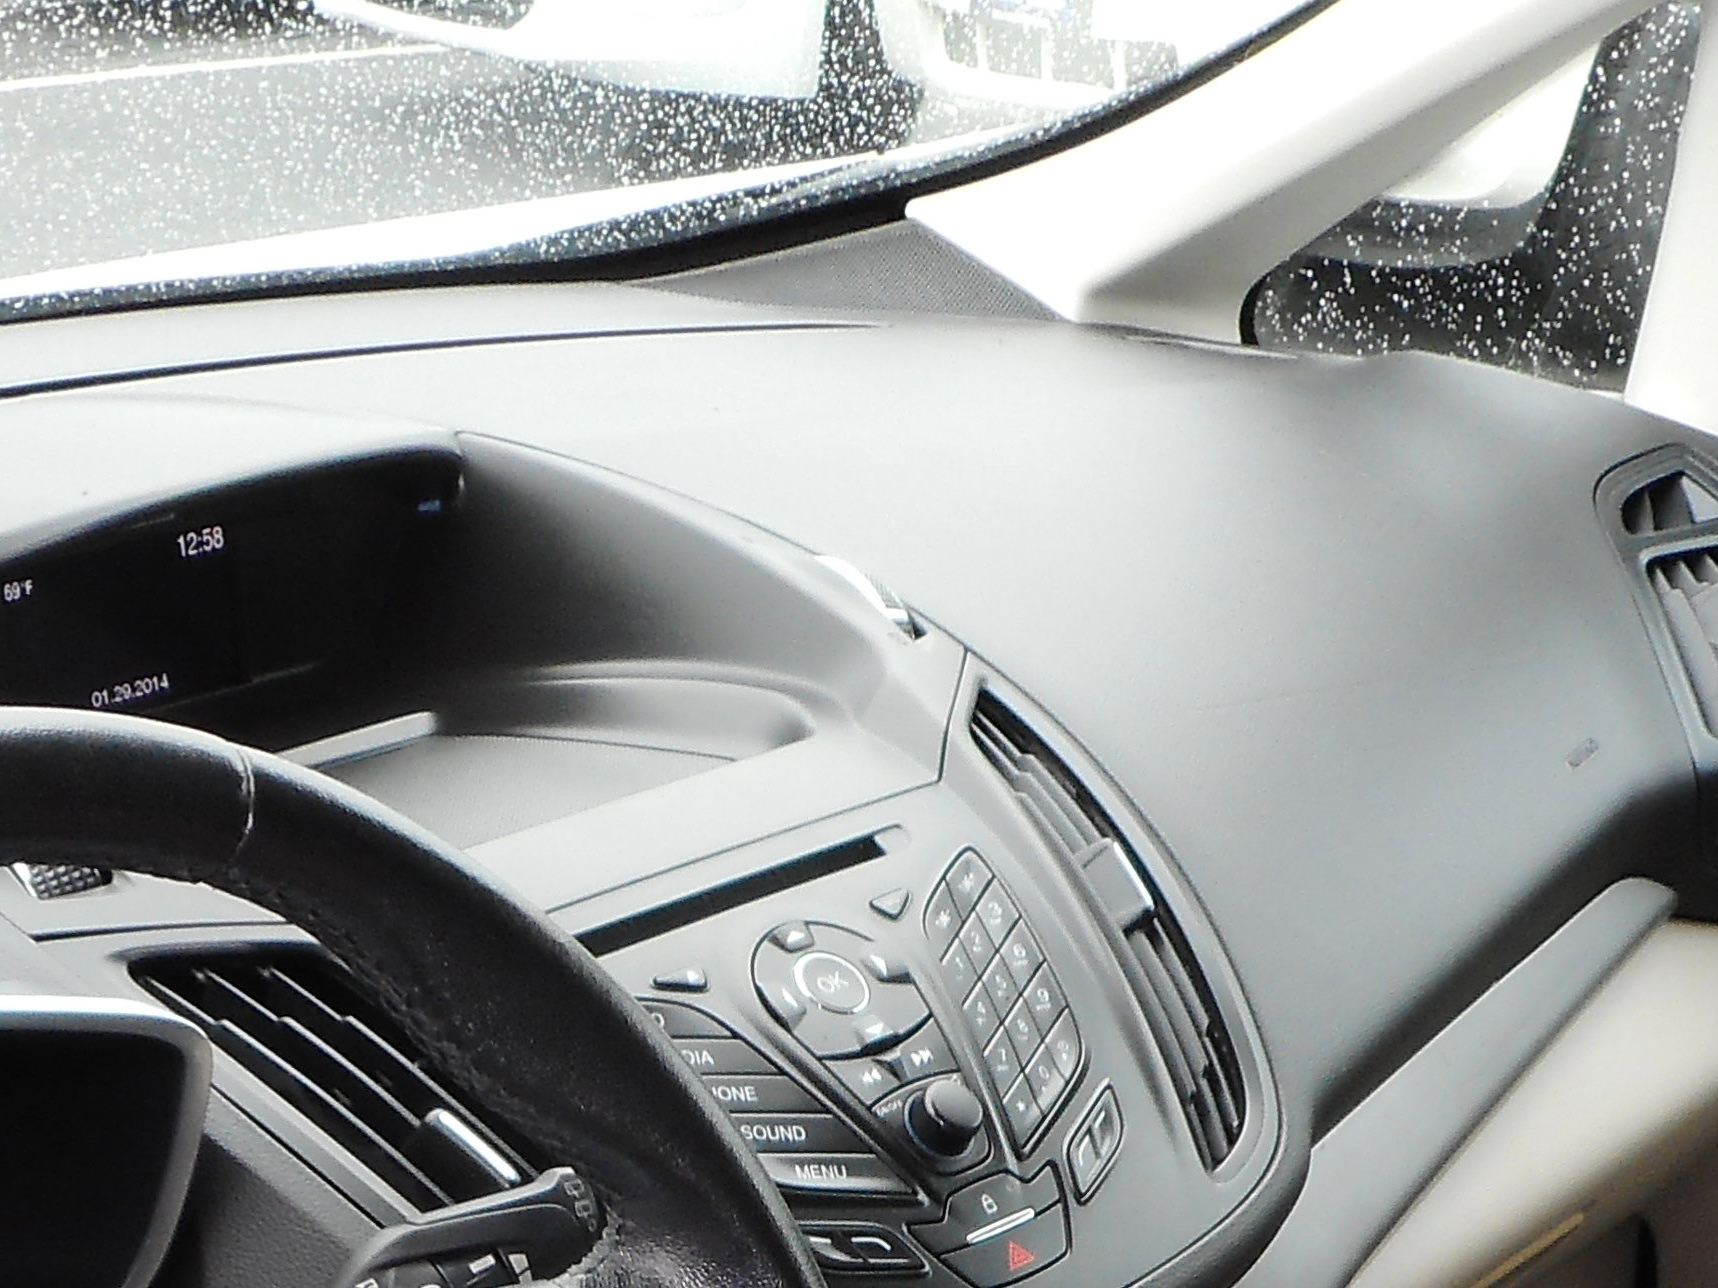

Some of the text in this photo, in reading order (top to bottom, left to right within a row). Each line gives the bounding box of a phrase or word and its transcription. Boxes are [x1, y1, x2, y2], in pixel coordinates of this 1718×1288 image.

[177, 526, 224, 557] 12:58
[816, 969, 850, 993] OK
[681, 1050, 714, 1065] DIA
[712, 1086, 757, 1102] ONE
[740, 1124, 806, 1142] SOUND
[795, 1164, 847, 1180] MENU
